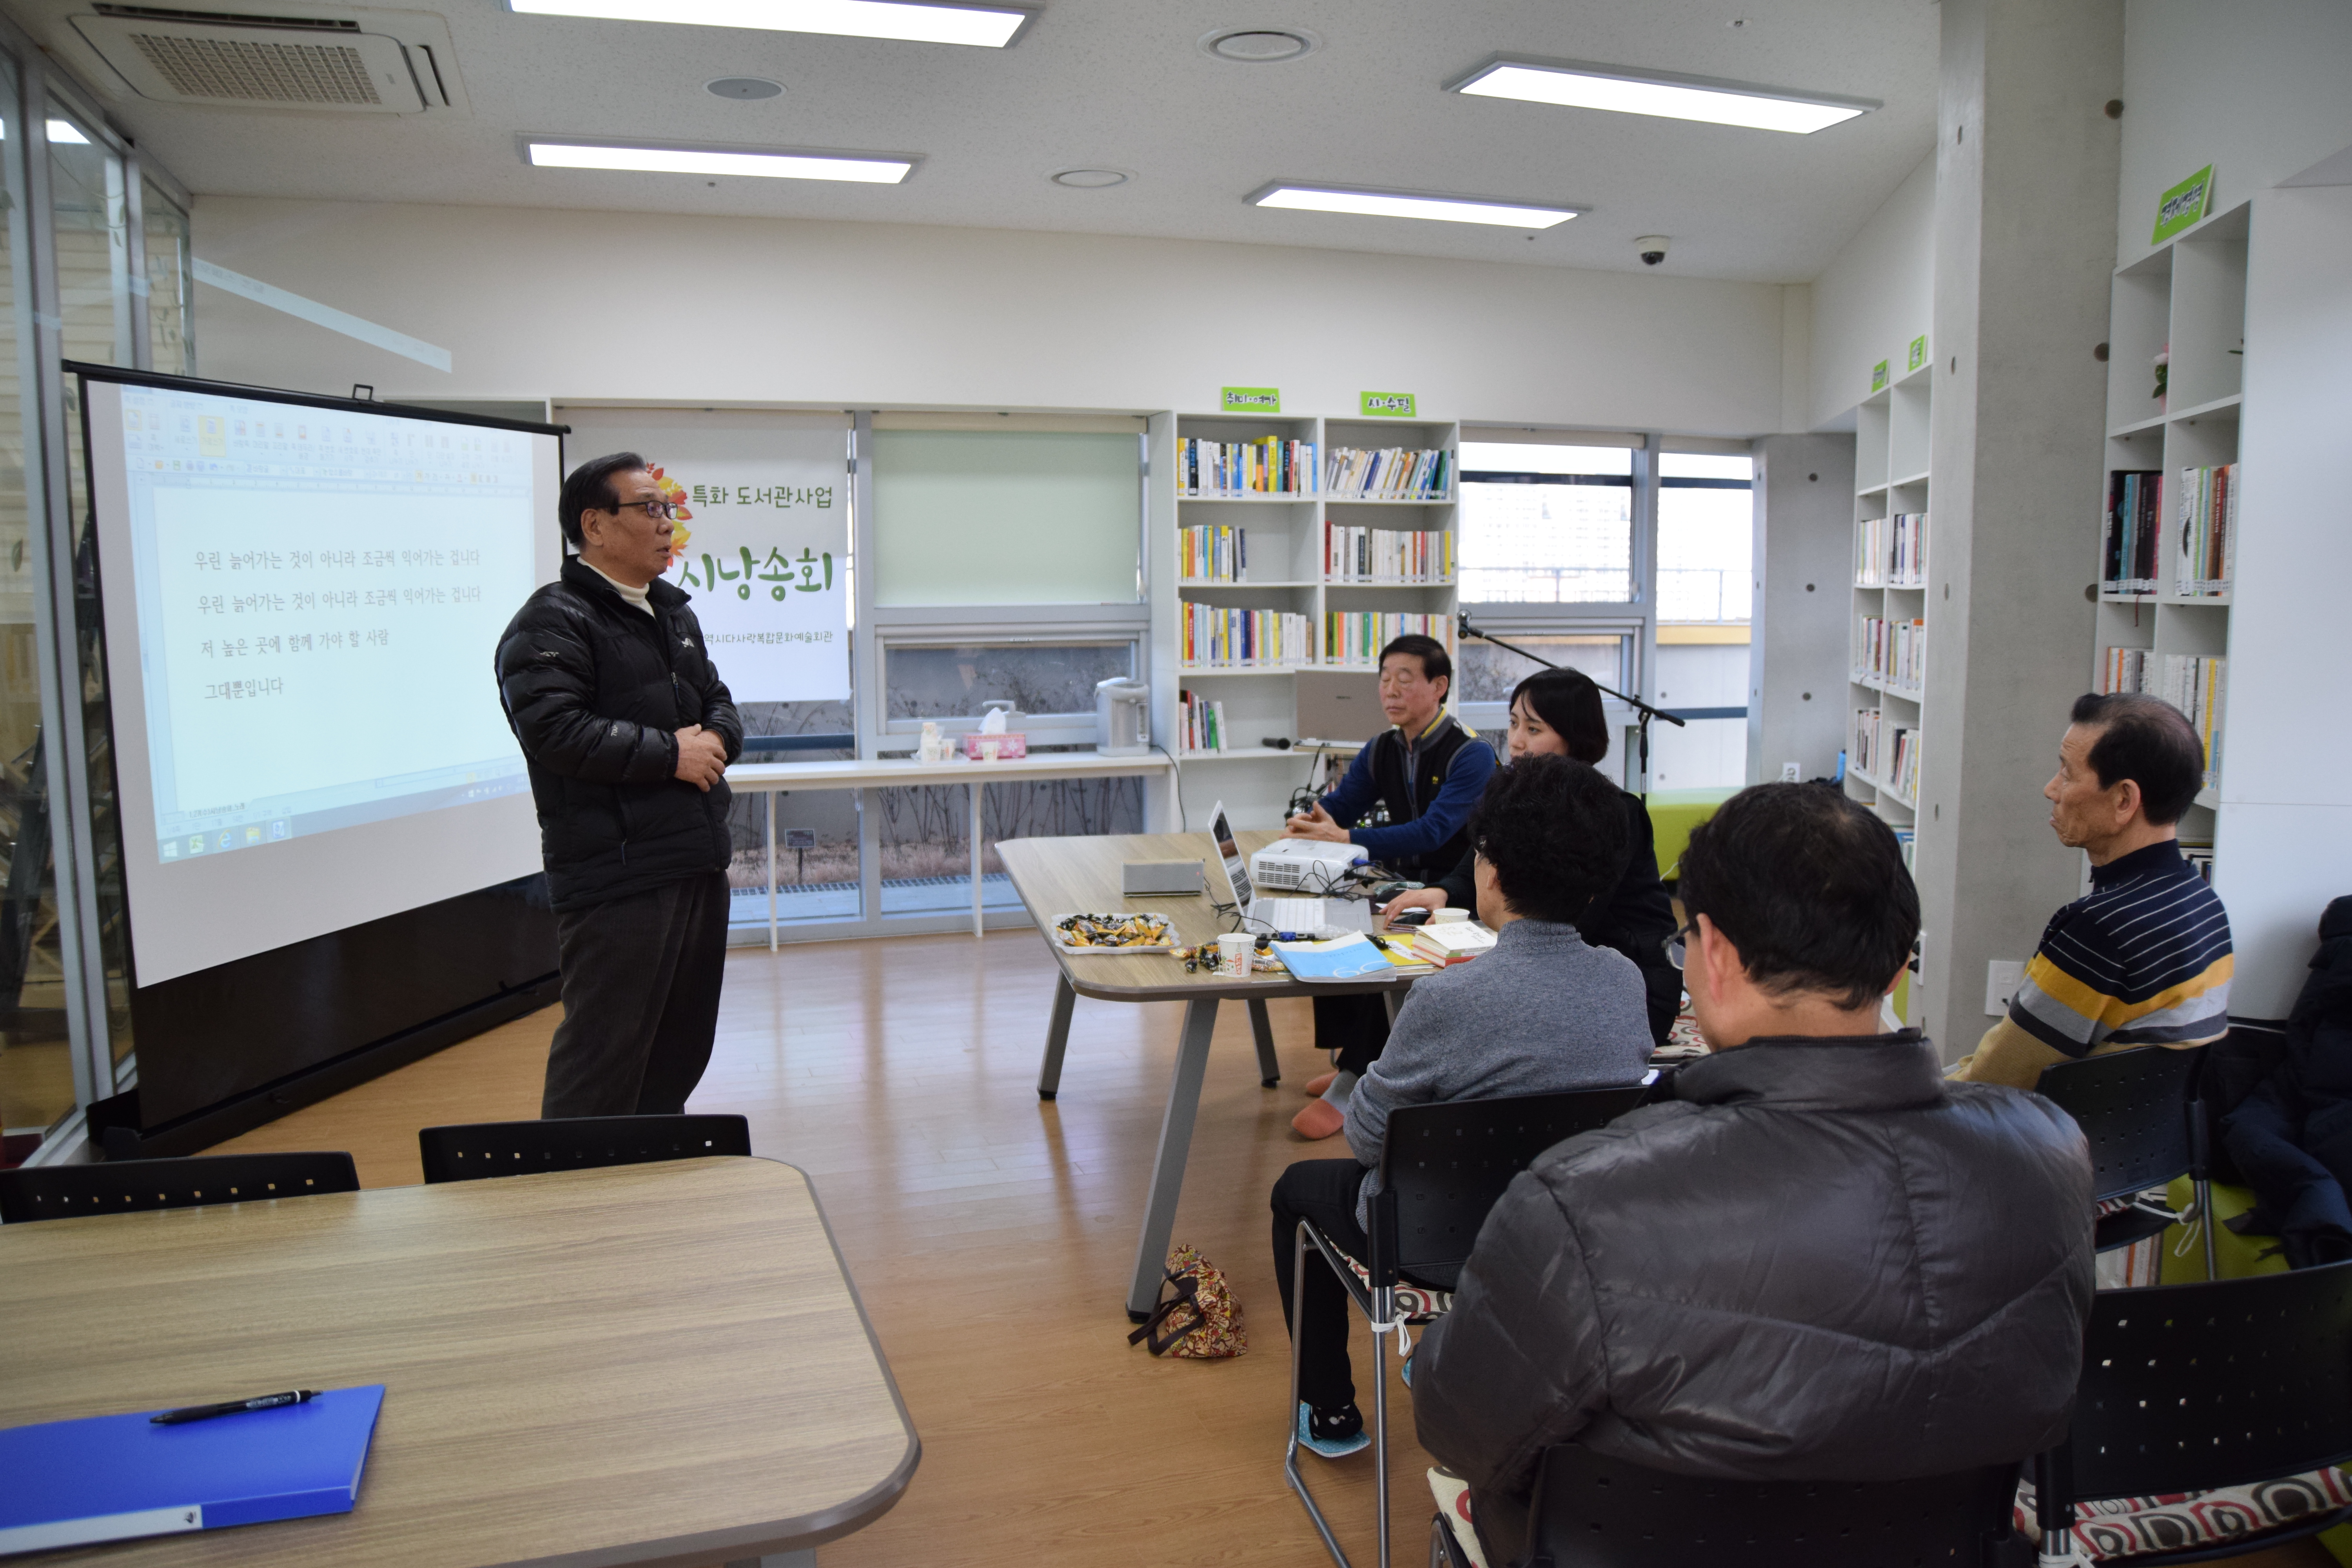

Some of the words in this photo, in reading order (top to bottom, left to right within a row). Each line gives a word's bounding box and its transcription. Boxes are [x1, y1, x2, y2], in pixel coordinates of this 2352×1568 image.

[1227, 391, 1277, 405] 취미·여가
[1368, 396, 1411, 412] 시·수필
[692, 485, 729, 508] 특화
[737, 486, 833, 508] 도서관사업
[194, 551, 221, 571] 우린
[229, 550, 282, 570] 늙어가는
[289, 550, 312, 569] 것이
[320, 550, 356, 568] 아니라
[362, 550, 394, 567] 조금씩
[401, 549, 444, 566] 익어가는
[450, 549, 480, 566] 겁니다
[677, 546, 833, 601] 시낭송회
[198, 595, 224, 615] 우린
[232, 593, 285, 612] 늙어가는
[292, 592, 315, 611] 것이
[322, 590, 358, 608] 아니라
[364, 588, 397, 606] 조금씩
[403, 587, 446, 605] 익어가는
[451, 586, 481, 603] 겁니다
[201, 640, 214, 659] 저
[221, 637, 248, 657] 높은
[255, 635, 281, 655] 곳에
[288, 633, 312, 652] 함께
[318, 631, 343, 650] 가야
[348, 630, 360, 647] 할
[366, 628, 389, 646] 사람
[204, 677, 284, 700] 그대뿐입니다
